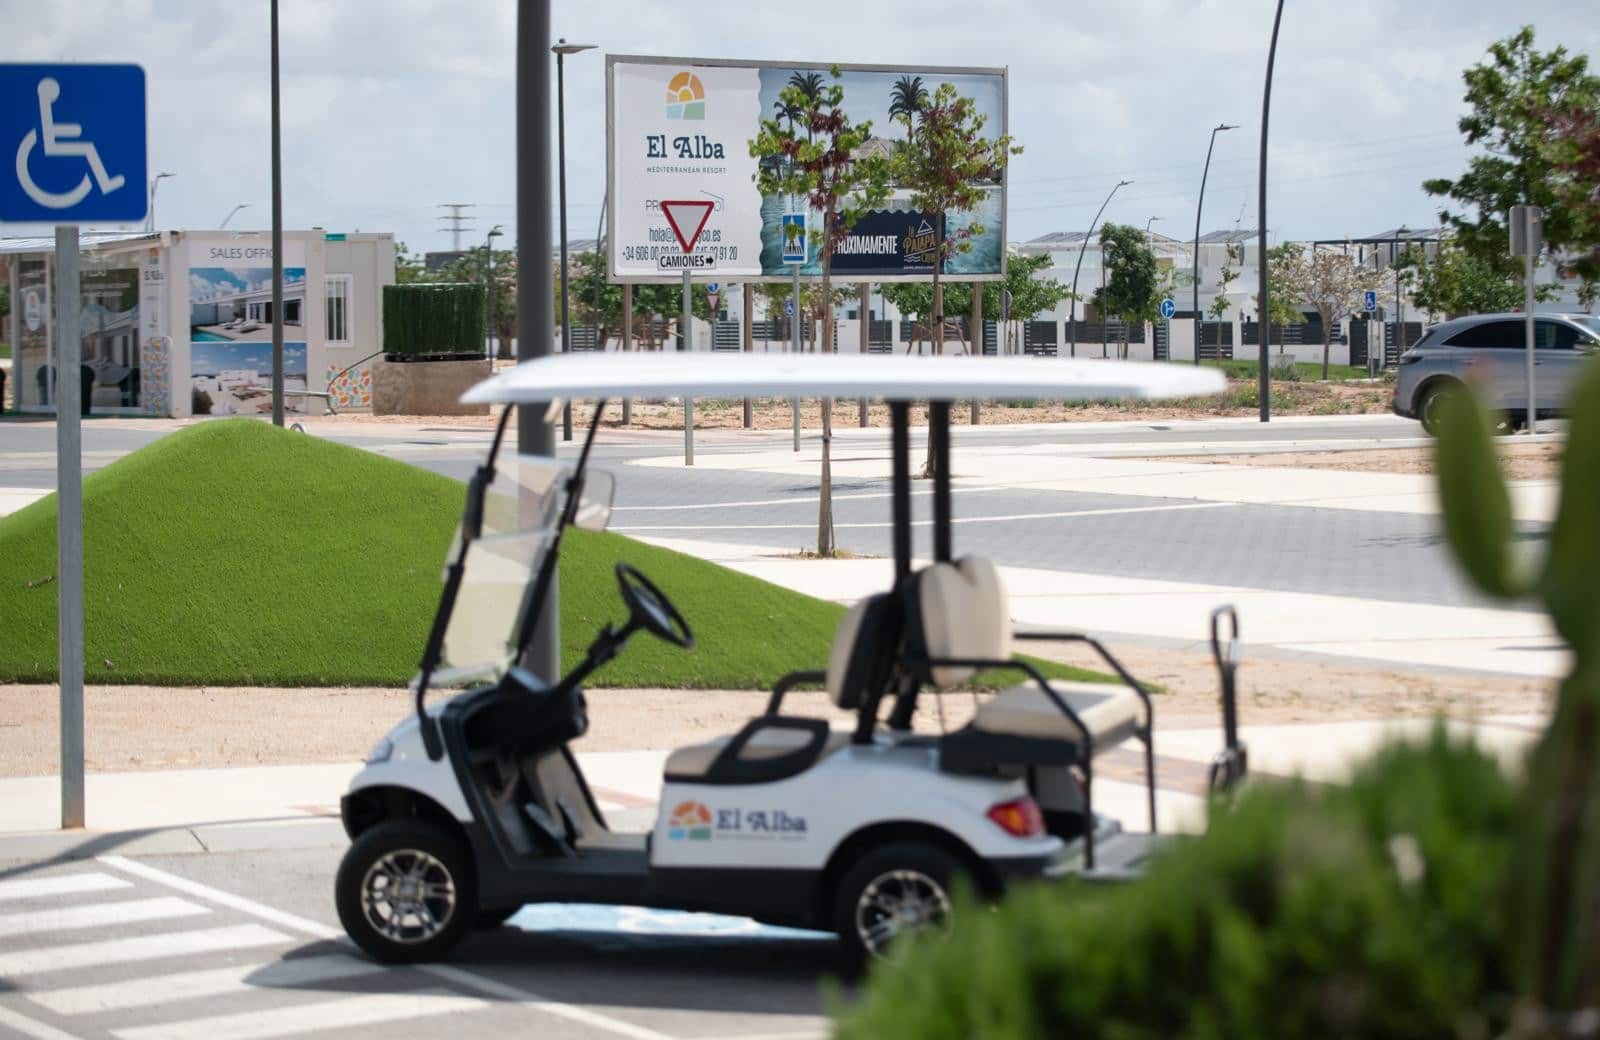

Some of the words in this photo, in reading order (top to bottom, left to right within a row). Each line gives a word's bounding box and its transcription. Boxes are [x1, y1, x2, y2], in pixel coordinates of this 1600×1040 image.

[646, 134, 668, 158] El
[673, 135, 725, 159] Alba
[209, 248, 242, 259] SALES
[660, 255, 705, 268] CAMIONES
[717, 808, 741, 830] El
[747, 810, 807, 832] Alba
